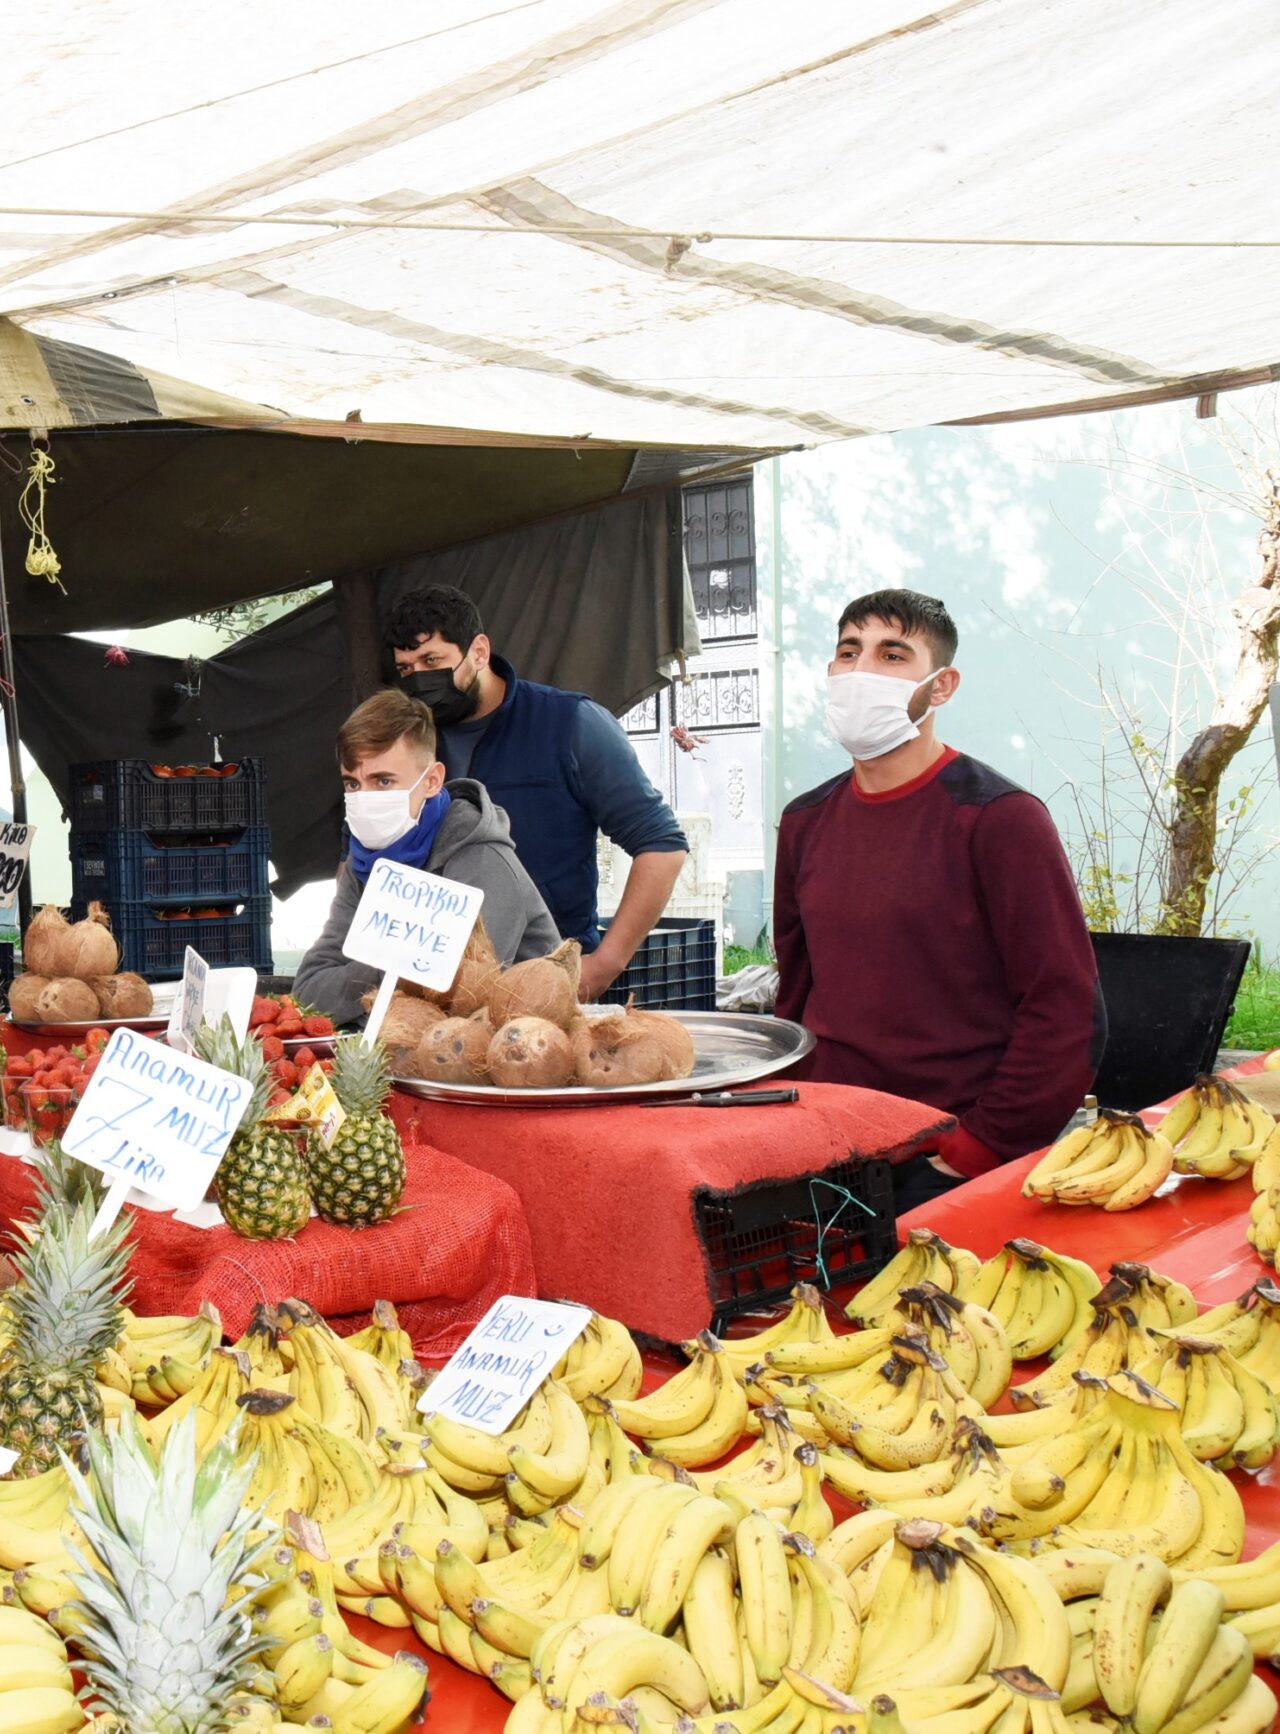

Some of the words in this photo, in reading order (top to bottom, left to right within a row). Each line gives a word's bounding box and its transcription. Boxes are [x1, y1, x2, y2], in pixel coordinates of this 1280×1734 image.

[362, 910, 451, 953] MEYVE
[153, 1105, 232, 1157] MUZ
[451, 1345, 547, 1396] ANAMUR
[439, 1379, 513, 1424] MUZ
